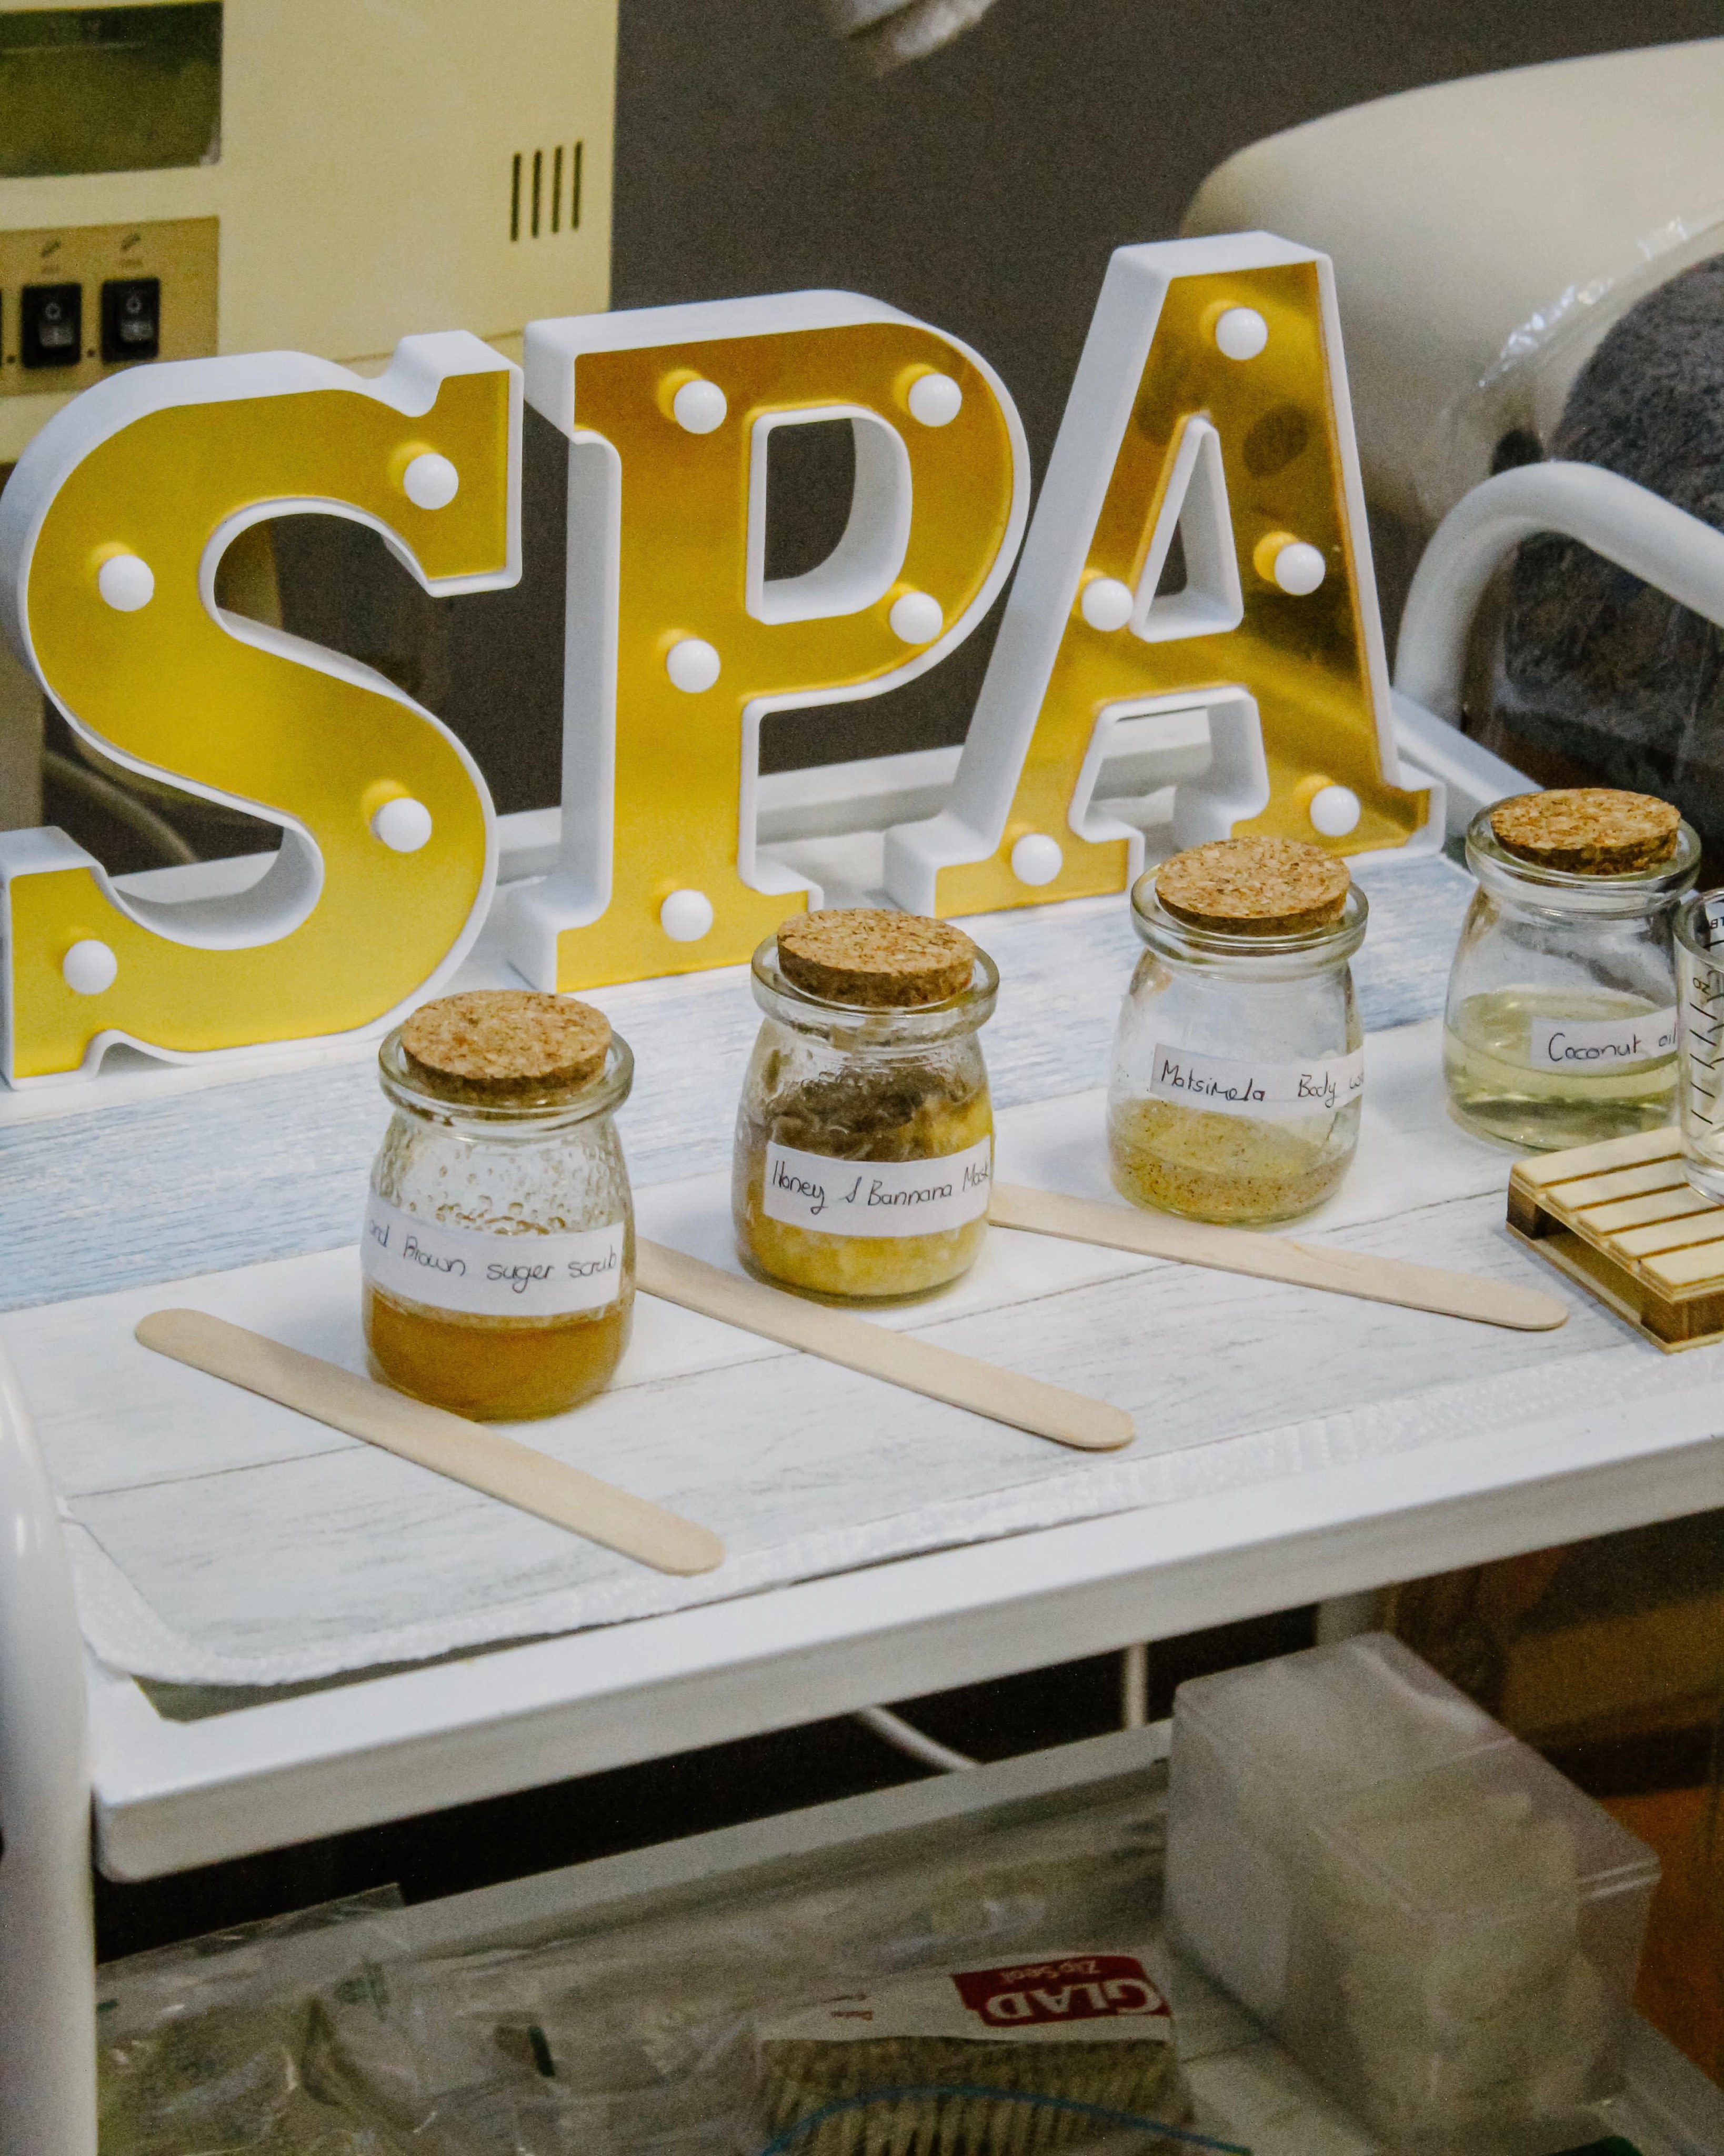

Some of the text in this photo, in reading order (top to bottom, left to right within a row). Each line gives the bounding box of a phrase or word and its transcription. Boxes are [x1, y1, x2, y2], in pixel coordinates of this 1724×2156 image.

[0, 231, 1447, 1091] SPA
[1548, 1021, 1677, 1062] Coconut oil
[1298, 1071, 1340, 1108] Body
[773, 1160, 829, 1215] Honey
[868, 1179, 952, 1206] Bannana
[403, 1232, 466, 1277] Brown
[568, 1243, 617, 1279] scrub
[985, 1978, 1162, 2020] GLAD
